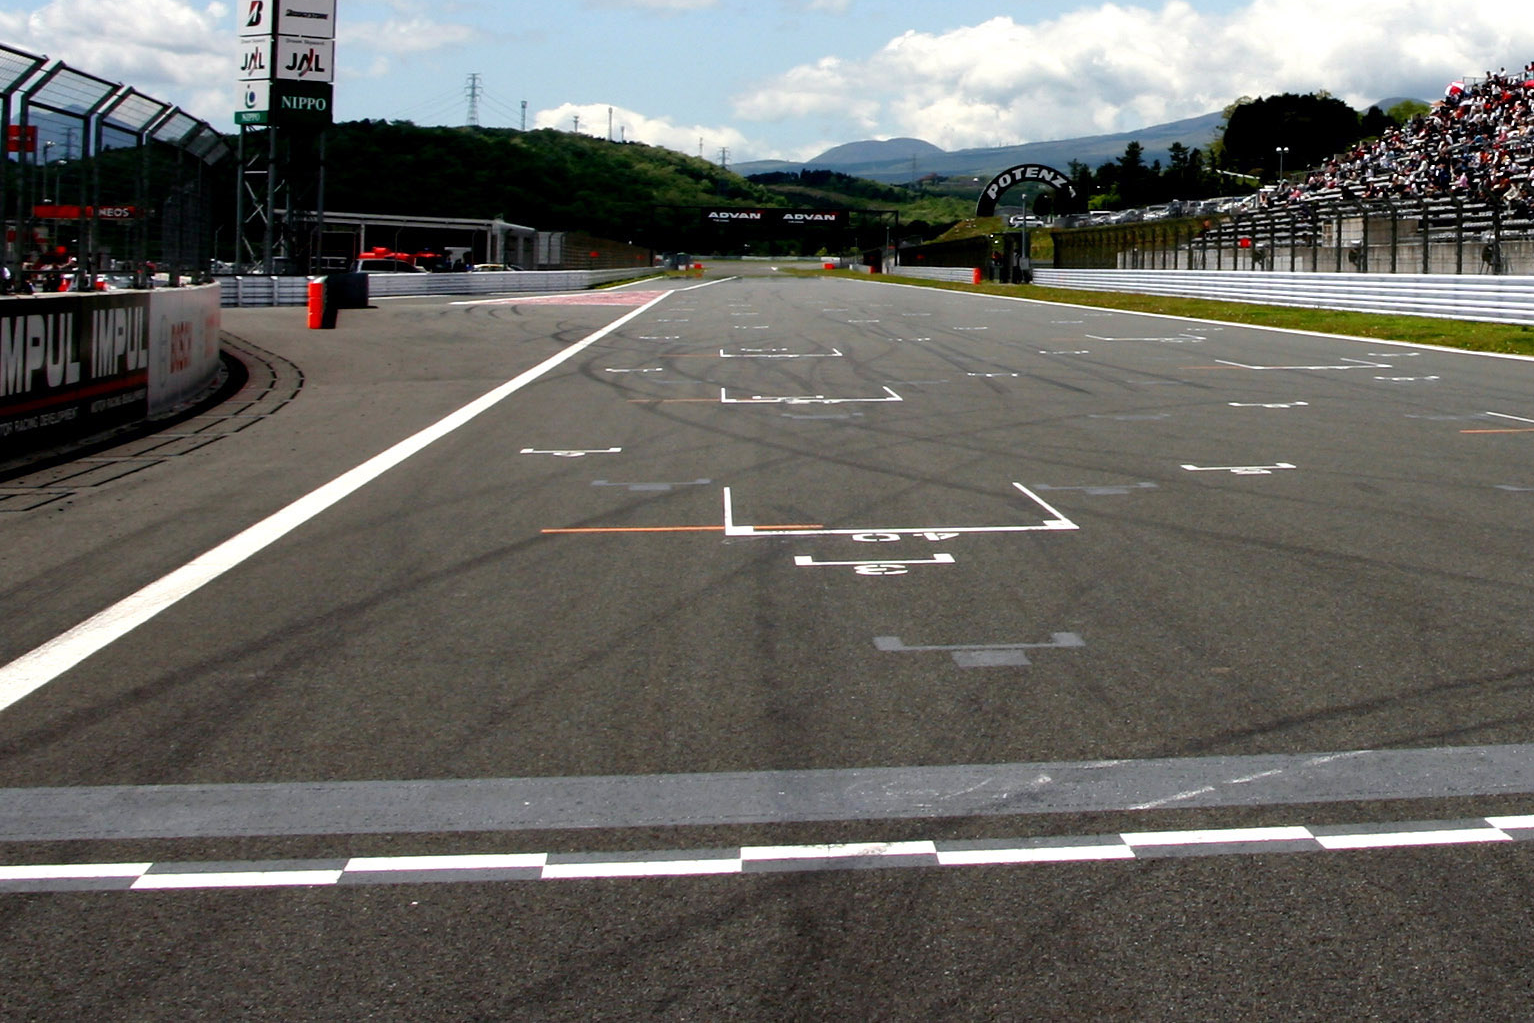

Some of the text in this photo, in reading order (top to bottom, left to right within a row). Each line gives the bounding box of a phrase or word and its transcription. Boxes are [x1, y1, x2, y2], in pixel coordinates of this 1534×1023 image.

[240, 47, 265, 75] JAL
[285, 48, 325, 77] JAL
[281, 96, 327, 111] NIPPO
[241, 113, 261, 122] NIPPO
[96, 207, 130, 217] NEOS
[91, 306, 148, 379] IMPUL
